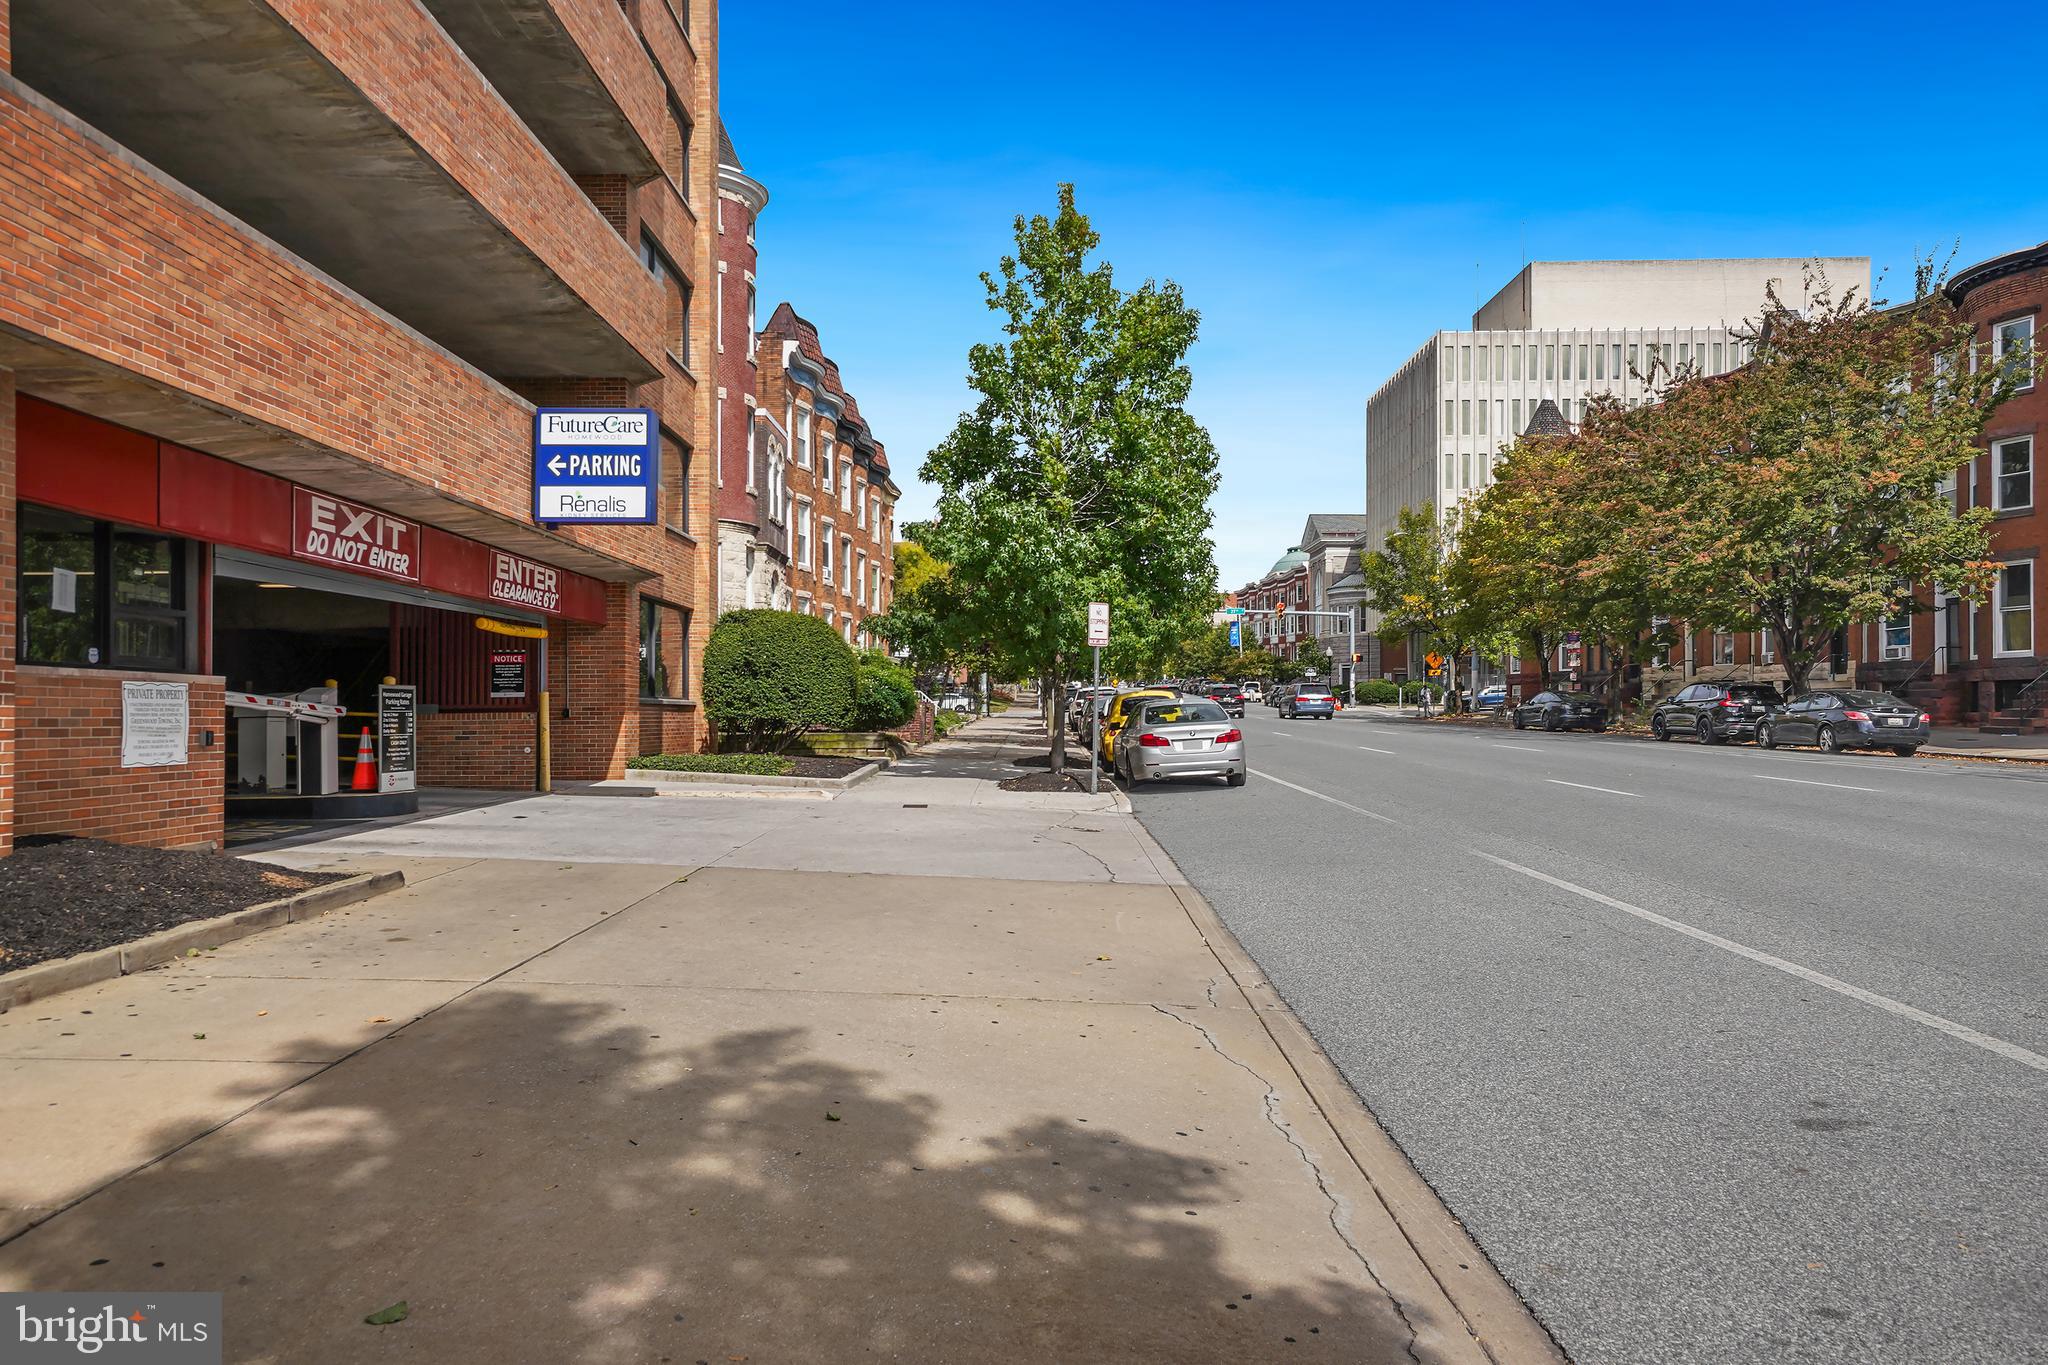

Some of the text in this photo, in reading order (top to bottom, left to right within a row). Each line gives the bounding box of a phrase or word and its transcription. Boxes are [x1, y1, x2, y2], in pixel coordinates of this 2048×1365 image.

[548, 415, 644, 433] FutureCare
[569, 454, 641, 477] PARKING
[311, 495, 407, 551] EXIT
[306, 529, 410, 575] DO NOT ENTER
[496, 553, 557, 593] ENTER
[492, 579, 543, 606] CLEARANCE
[494, 655, 523, 663] NOTICE
[127, 688, 184, 700] PRIVATE PROPERTY
